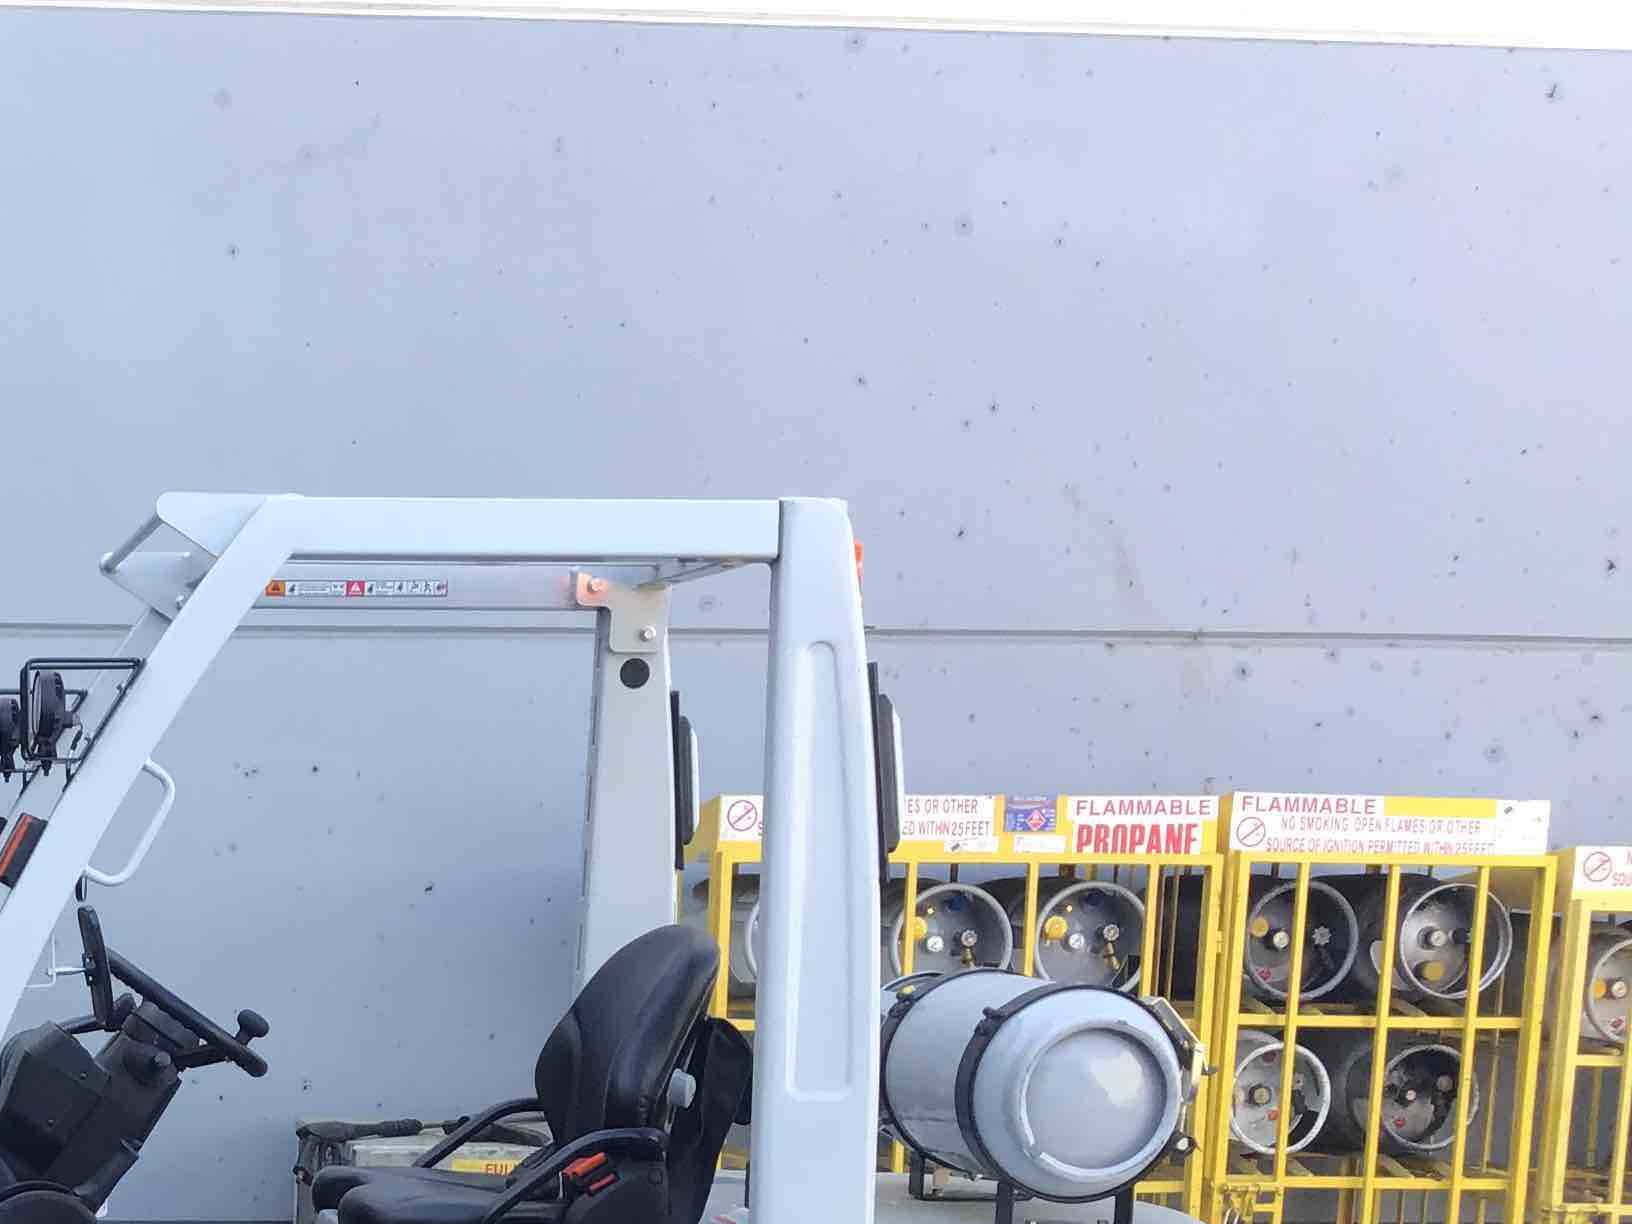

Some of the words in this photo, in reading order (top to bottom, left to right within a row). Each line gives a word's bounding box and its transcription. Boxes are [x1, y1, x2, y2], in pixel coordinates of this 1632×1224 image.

[924, 799, 939, 814] OR
[943, 799, 978, 815] OTHER
[1075, 799, 1212, 816] FLAMMABLE
[1241, 795, 1377, 815] FLAMMABLE
[965, 820, 990, 837] FEET
[1281, 815, 1296, 832] NO
[1299, 816, 1349, 833] SMOKING
[1354, 817, 1383, 833] OPEN
[1384, 817, 1425, 835] FLAMES
